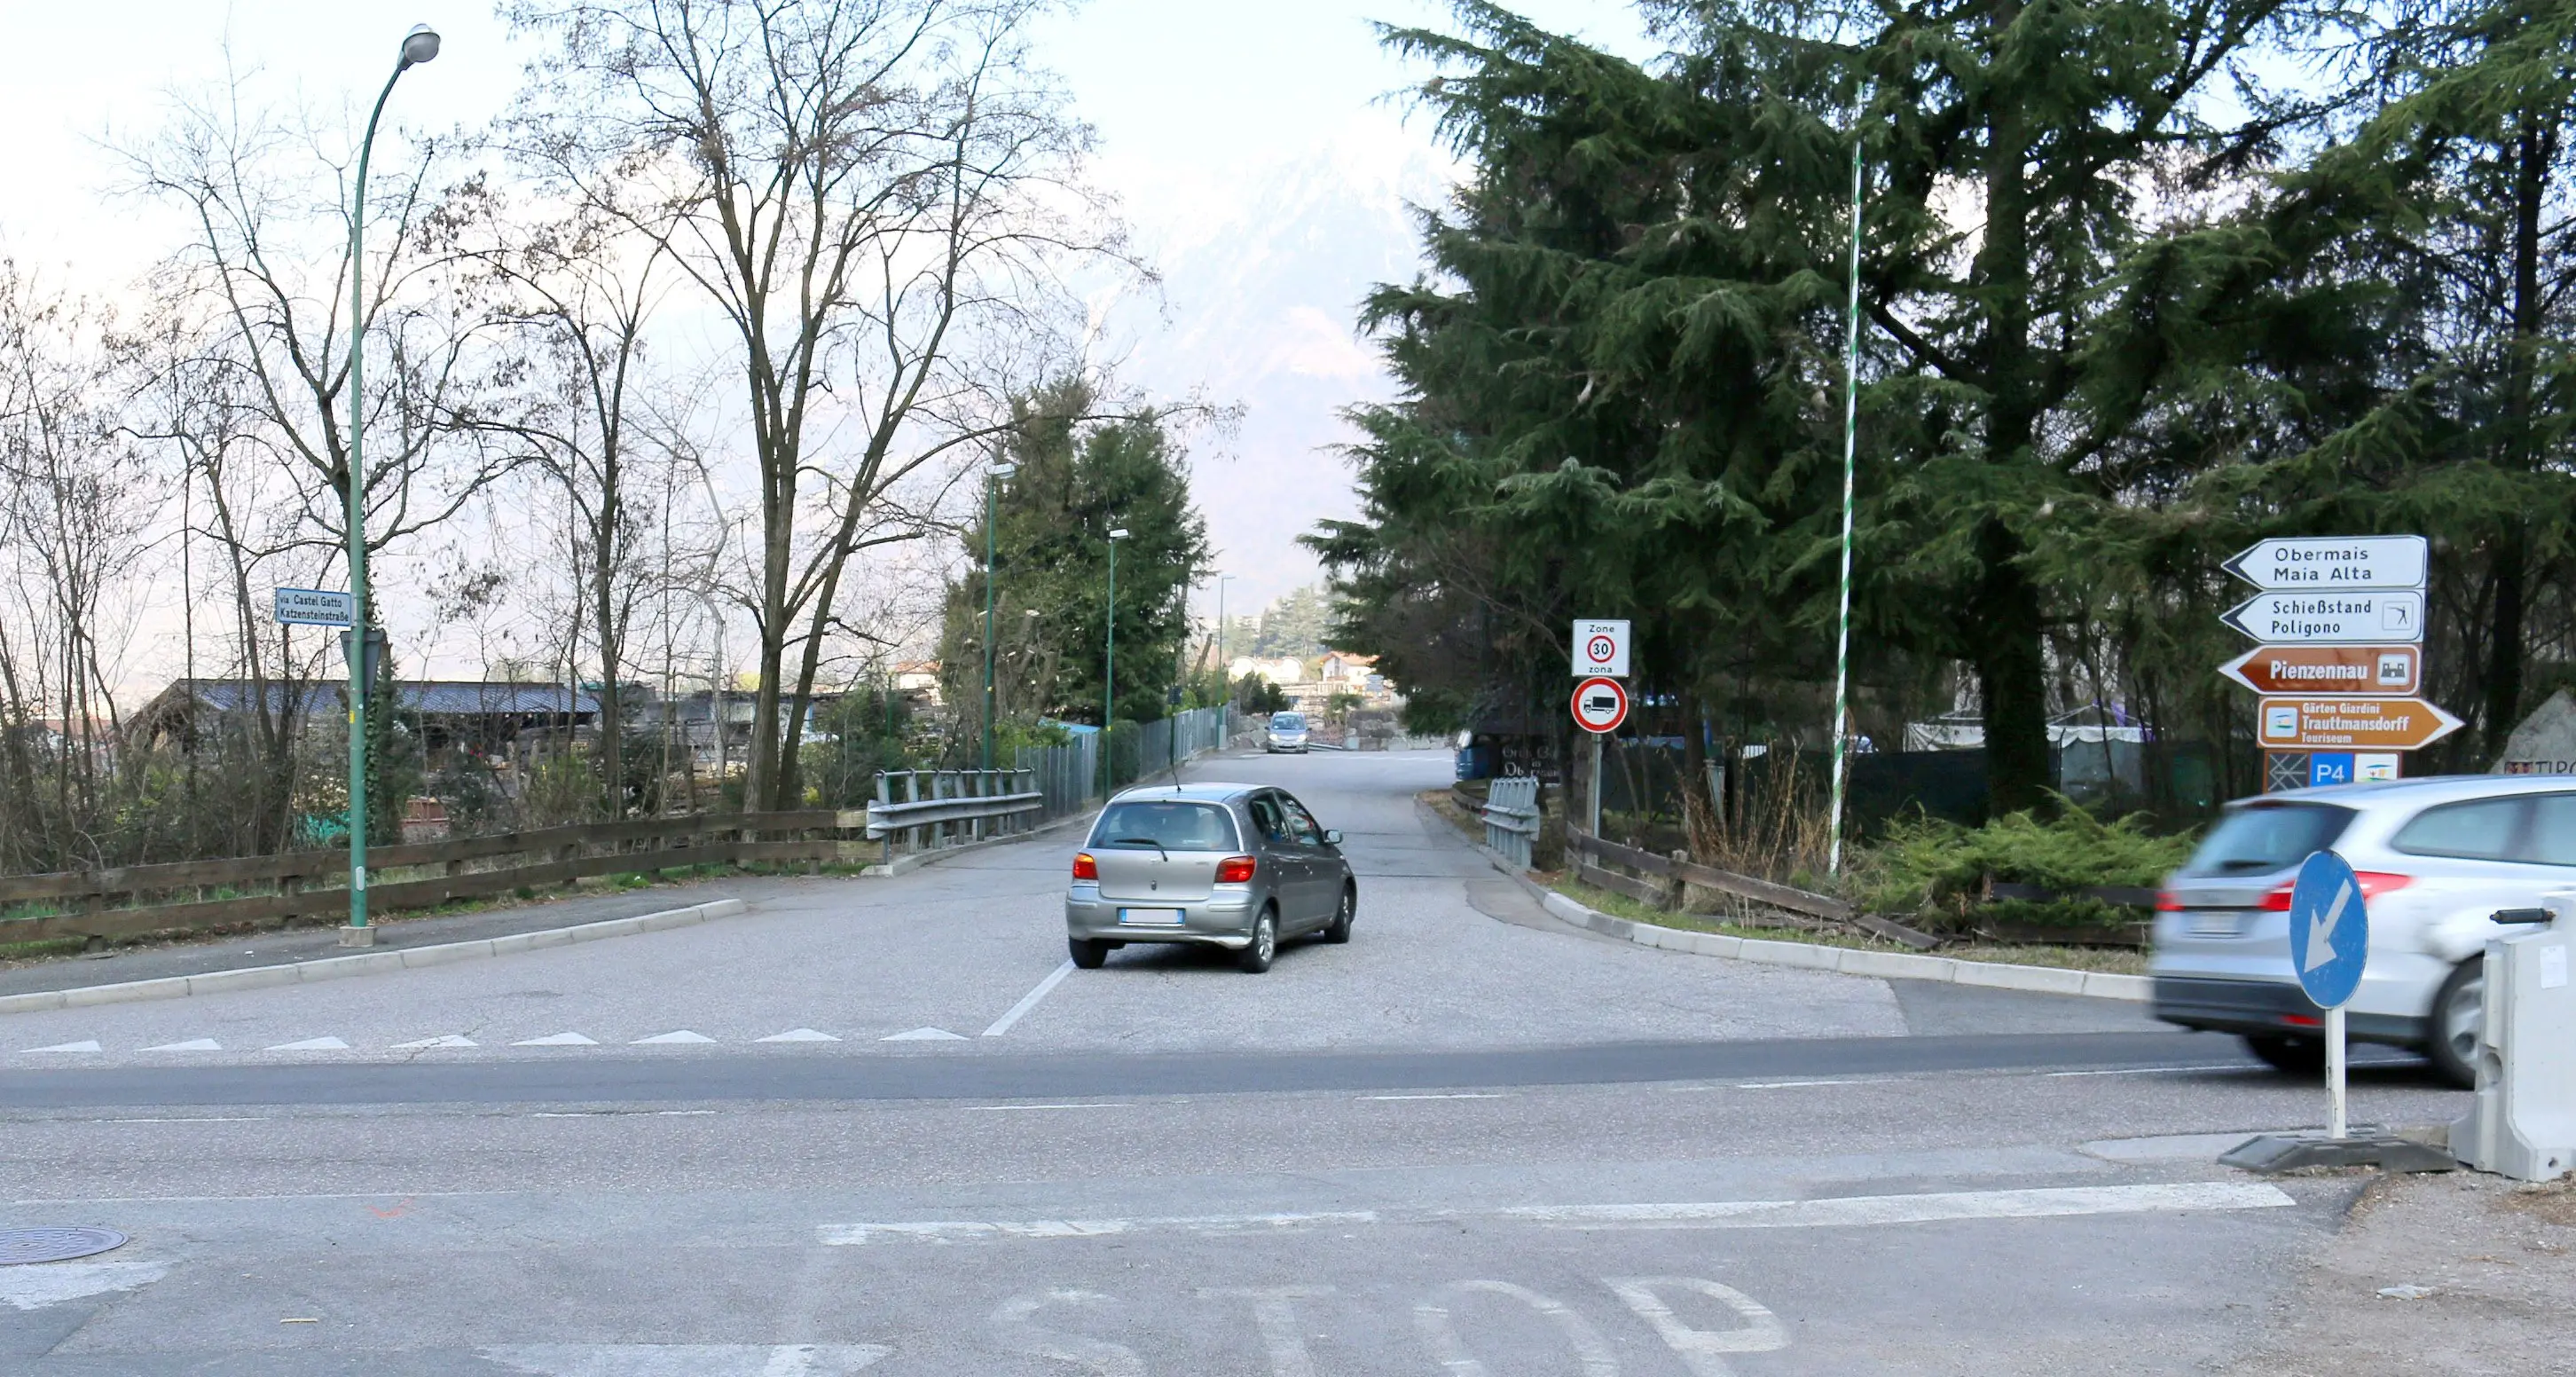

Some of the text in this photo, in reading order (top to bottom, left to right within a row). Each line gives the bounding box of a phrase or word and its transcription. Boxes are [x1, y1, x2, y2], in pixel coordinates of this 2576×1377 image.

[2275, 547, 2368, 562] Obermais
[2274, 567, 2372, 581] Maia Alta
[294, 594, 318, 606] Castel
[320, 596, 342, 608] Gatto
[2273, 600, 2371, 614] Schießstand
[279, 607, 349, 621] Katzensteinstraße
[2272, 620, 2340, 637] Poligono
[1593, 643, 1609, 655] 30
[2270, 660, 2368, 680] Pienzennau
[2303, 703, 2380, 714] Gärten Giardini
[2303, 715, 2410, 731] Trauttmansdorff
[2302, 732, 2352, 744] Touriseum
[2316, 764, 2345, 783] P4
